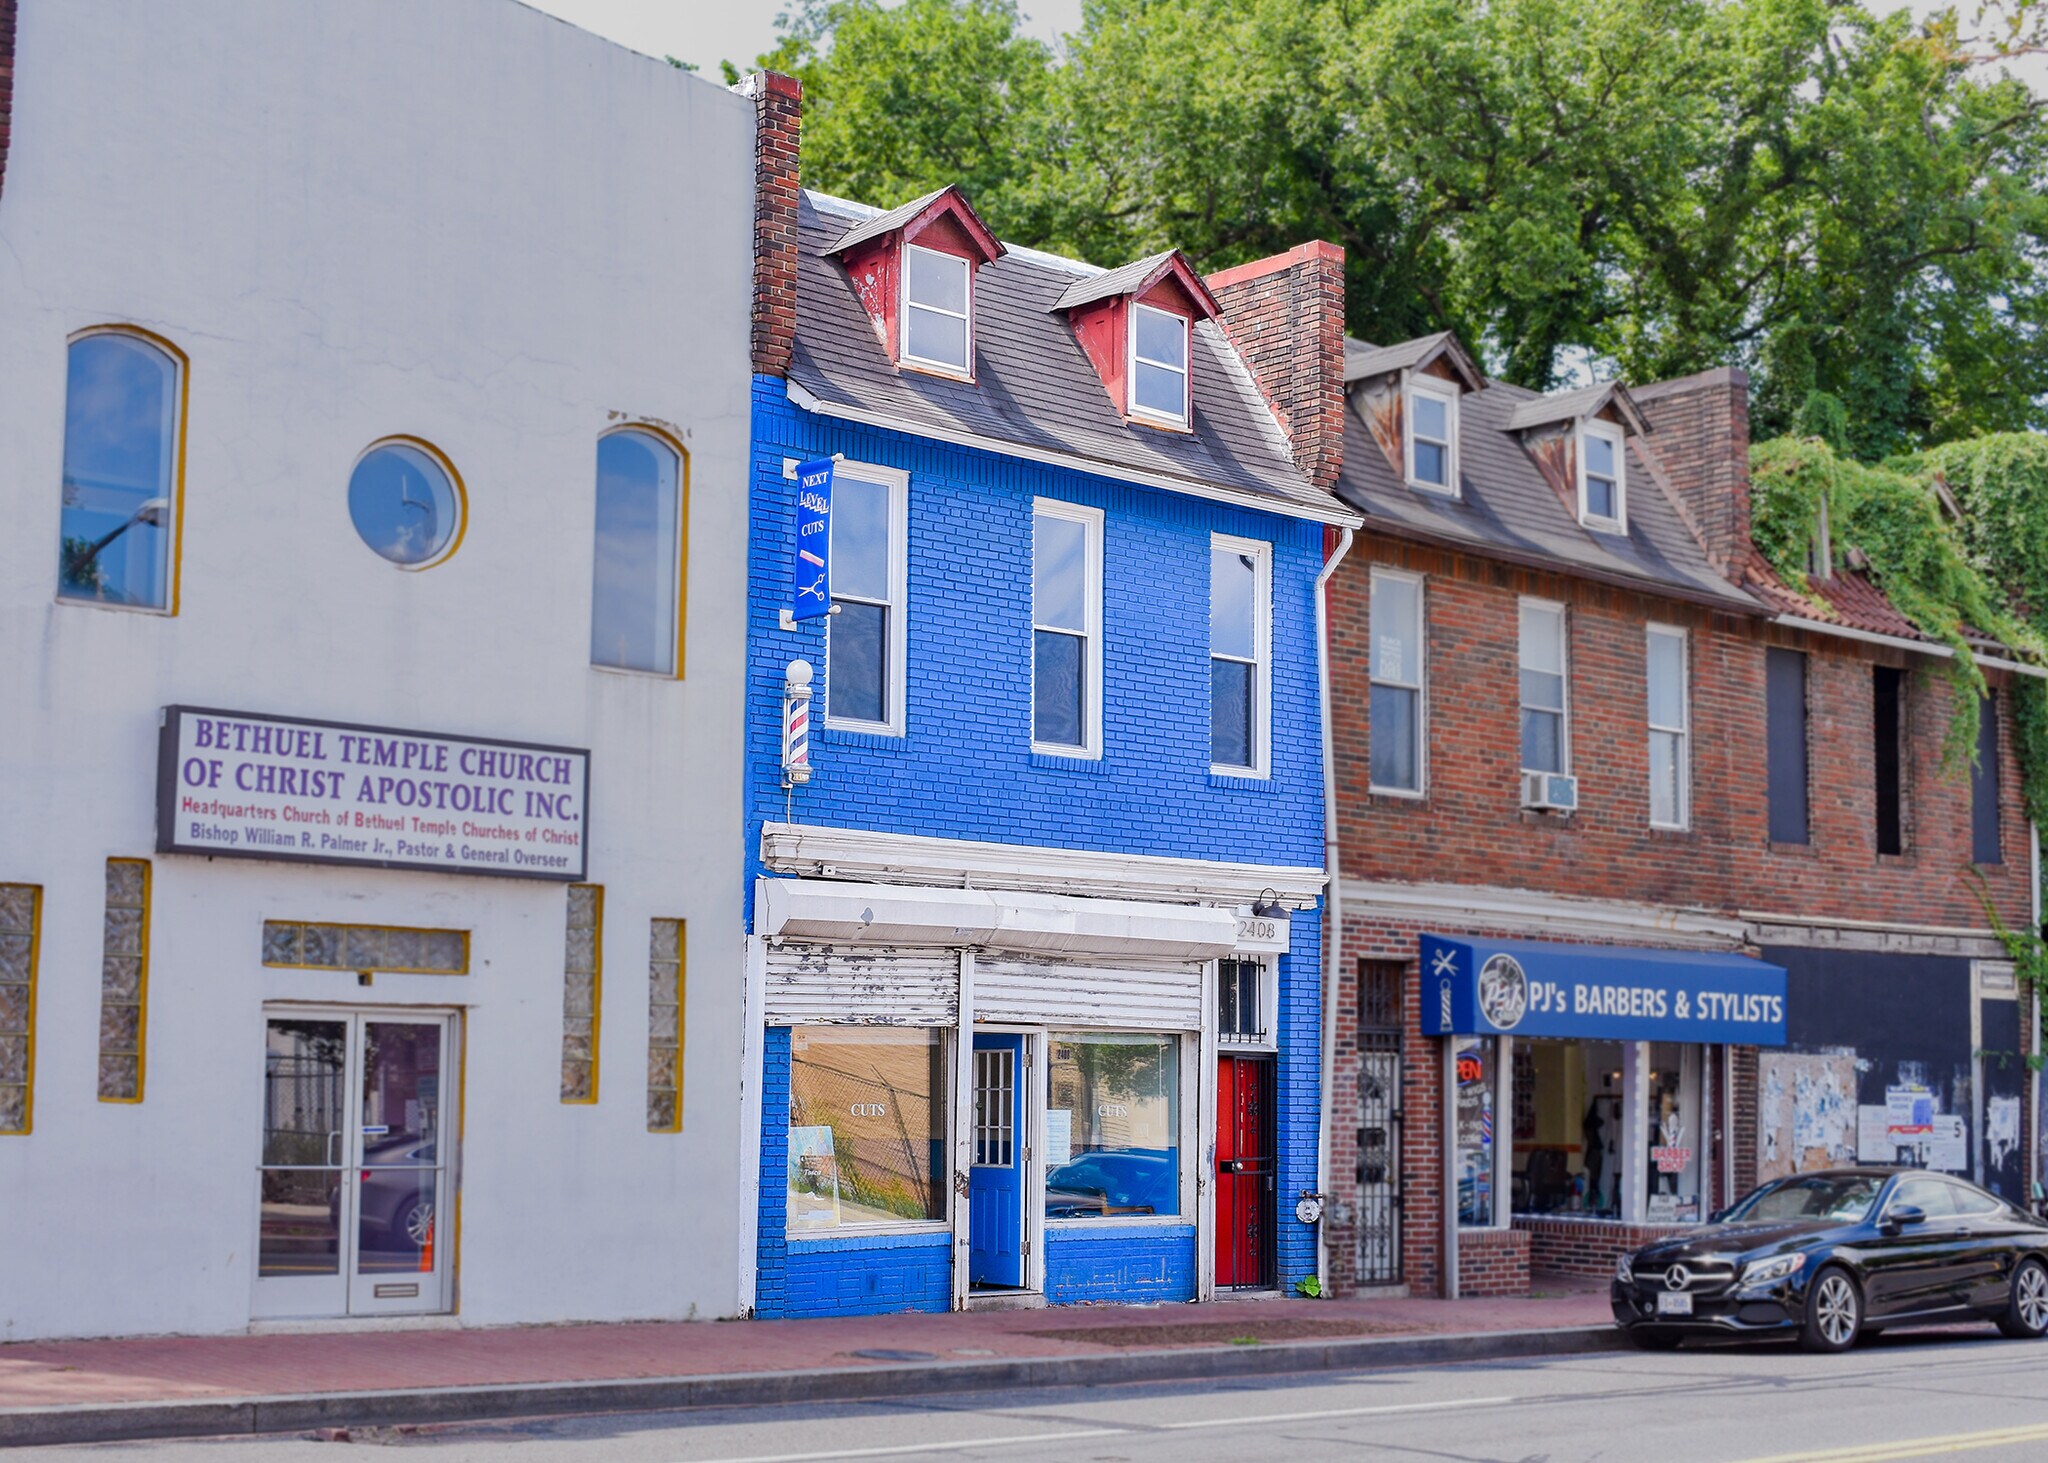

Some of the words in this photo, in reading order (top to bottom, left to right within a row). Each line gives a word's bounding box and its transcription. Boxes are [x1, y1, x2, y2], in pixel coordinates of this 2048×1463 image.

[802, 471, 829, 488] NEXT
[799, 491, 829, 514] LEVEL
[801, 520, 825, 537] CUTS
[195, 719, 327, 760] BETHUEL
[339, 735, 448, 772] TEMPLE
[460, 748, 571, 785] CHURCH
[183, 757, 223, 788] OF
[235, 762, 345, 800] CHRIST
[357, 775, 514, 816] APOSTOLIC
[525, 791, 579, 821] INC.
[182, 797, 277, 820] Headquarters
[283, 805, 330, 825] Church
[337, 811, 349, 826] of
[354, 812, 405, 832] Bethuel
[411, 816, 456, 838] Temple
[462, 821, 519, 841] Churches
[525, 827, 537, 842] of
[542, 828, 579, 846] Christ
[190, 822, 239, 845] Bishop
[245, 826, 296, 847] William
[301, 832, 315, 848] R.
[321, 833, 367, 853] Palmer
[373, 838, 393, 858] Jr.,
[397, 840, 439, 858] Pastor
[445, 843, 455, 859] &
[461, 845, 509, 863] General
[514, 849, 568, 868] Overseer
[1238, 920, 1275, 939] 2408
[1529, 982, 1567, 1013] PJ's
[1574, 985, 1667, 1018] BARBERS
[1674, 990, 1690, 1018] &
[1696, 991, 1783, 1023] STYLISTS
[1456, 1060, 1482, 1081] PEN
[851, 1103, 885, 1117] CUTS
[1098, 1105, 1128, 1118] CUTS
[1652, 1146, 1691, 1161] BARBER
[1658, 1160, 1686, 1172] SHOP
